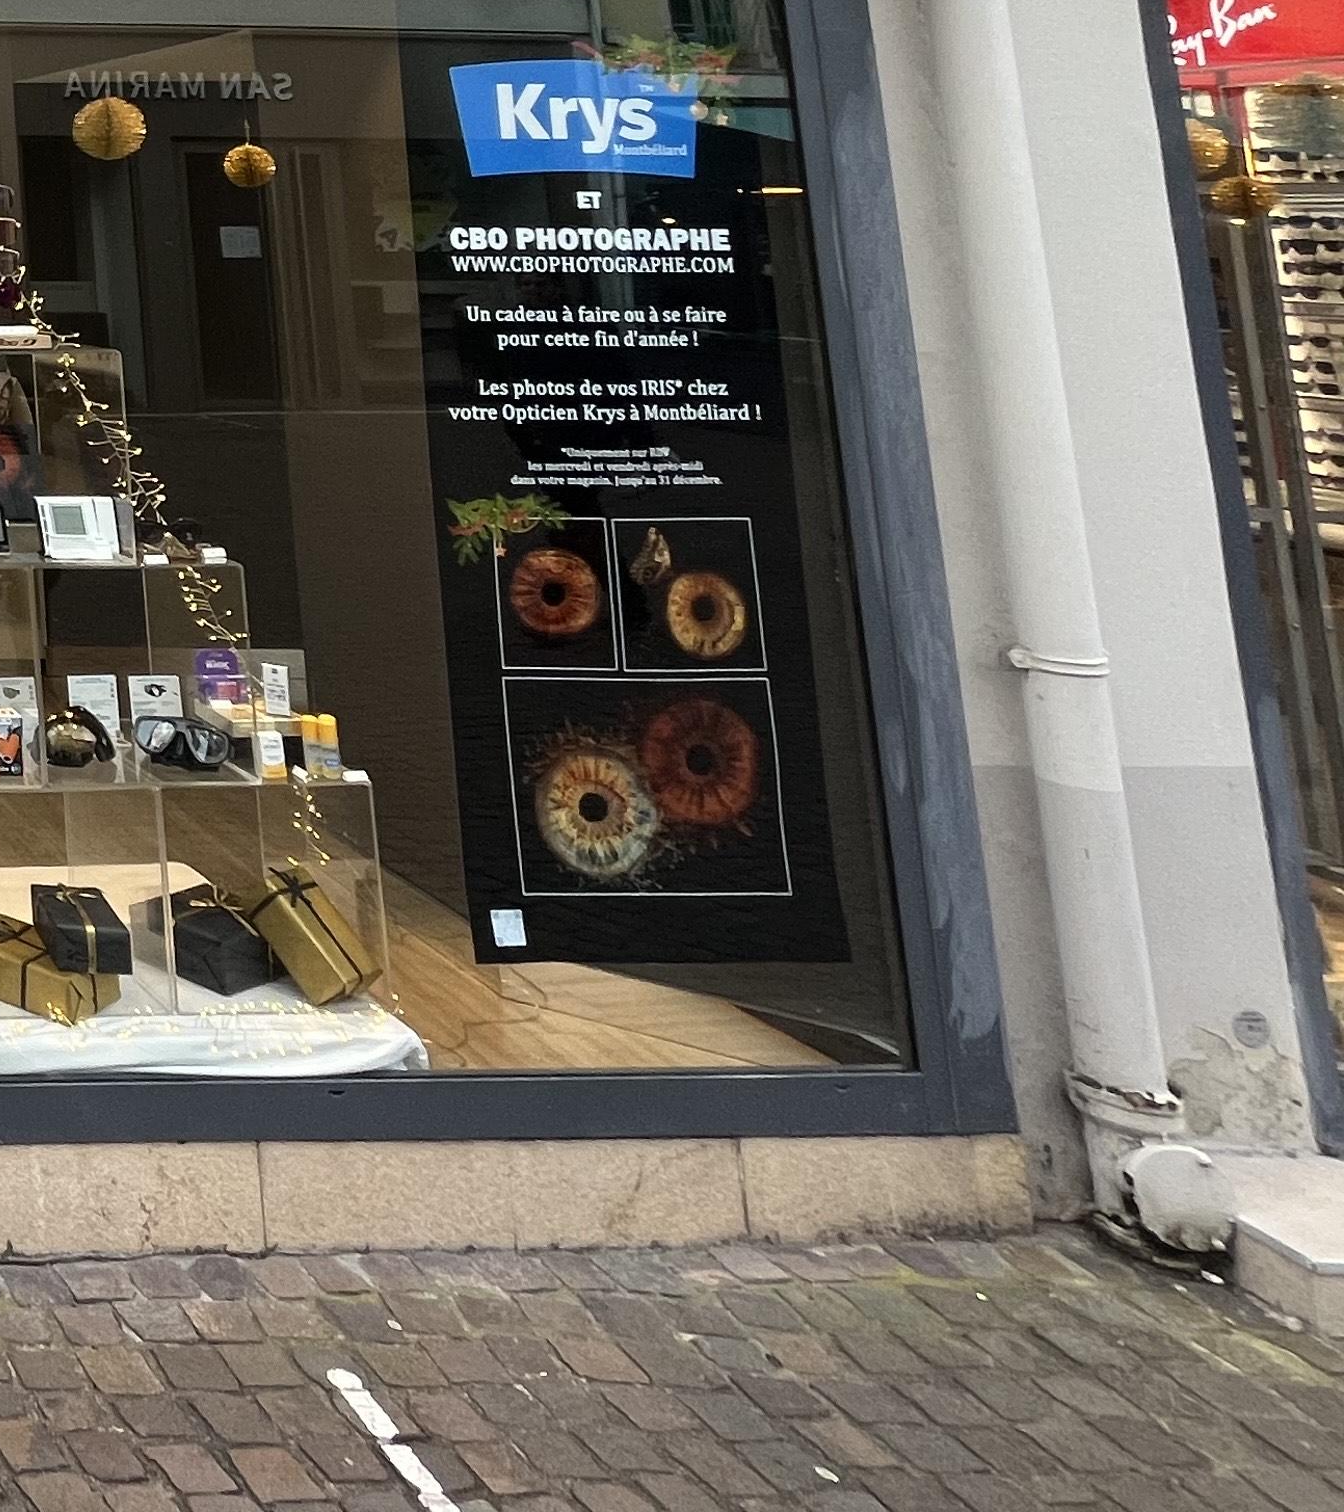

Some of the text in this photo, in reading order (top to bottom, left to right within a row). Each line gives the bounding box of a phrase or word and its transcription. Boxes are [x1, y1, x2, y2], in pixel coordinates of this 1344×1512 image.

[496, 83, 656, 154] Krys
[614, 144, 687, 156] Montbéliard
[576, 192, 601, 209] ET
[450, 228, 731, 252] CBO PHOTOGRAPHE
[452, 256, 734, 273] WWW.CBOPHOTOGRAPHE.COM
[466, 305, 726, 322] Un cadeau à faire ou à se faire
[497, 331, 698, 350] pour cette fin d'année !
[479, 380, 508, 396] Les
[513, 380, 574, 399] photos
[580, 380, 602, 396] de
[607, 384, 637, 396] vos
[688, 380, 728, 396] chez
[449, 403, 761, 425] votre Opticien Krys à Montbéliard !
